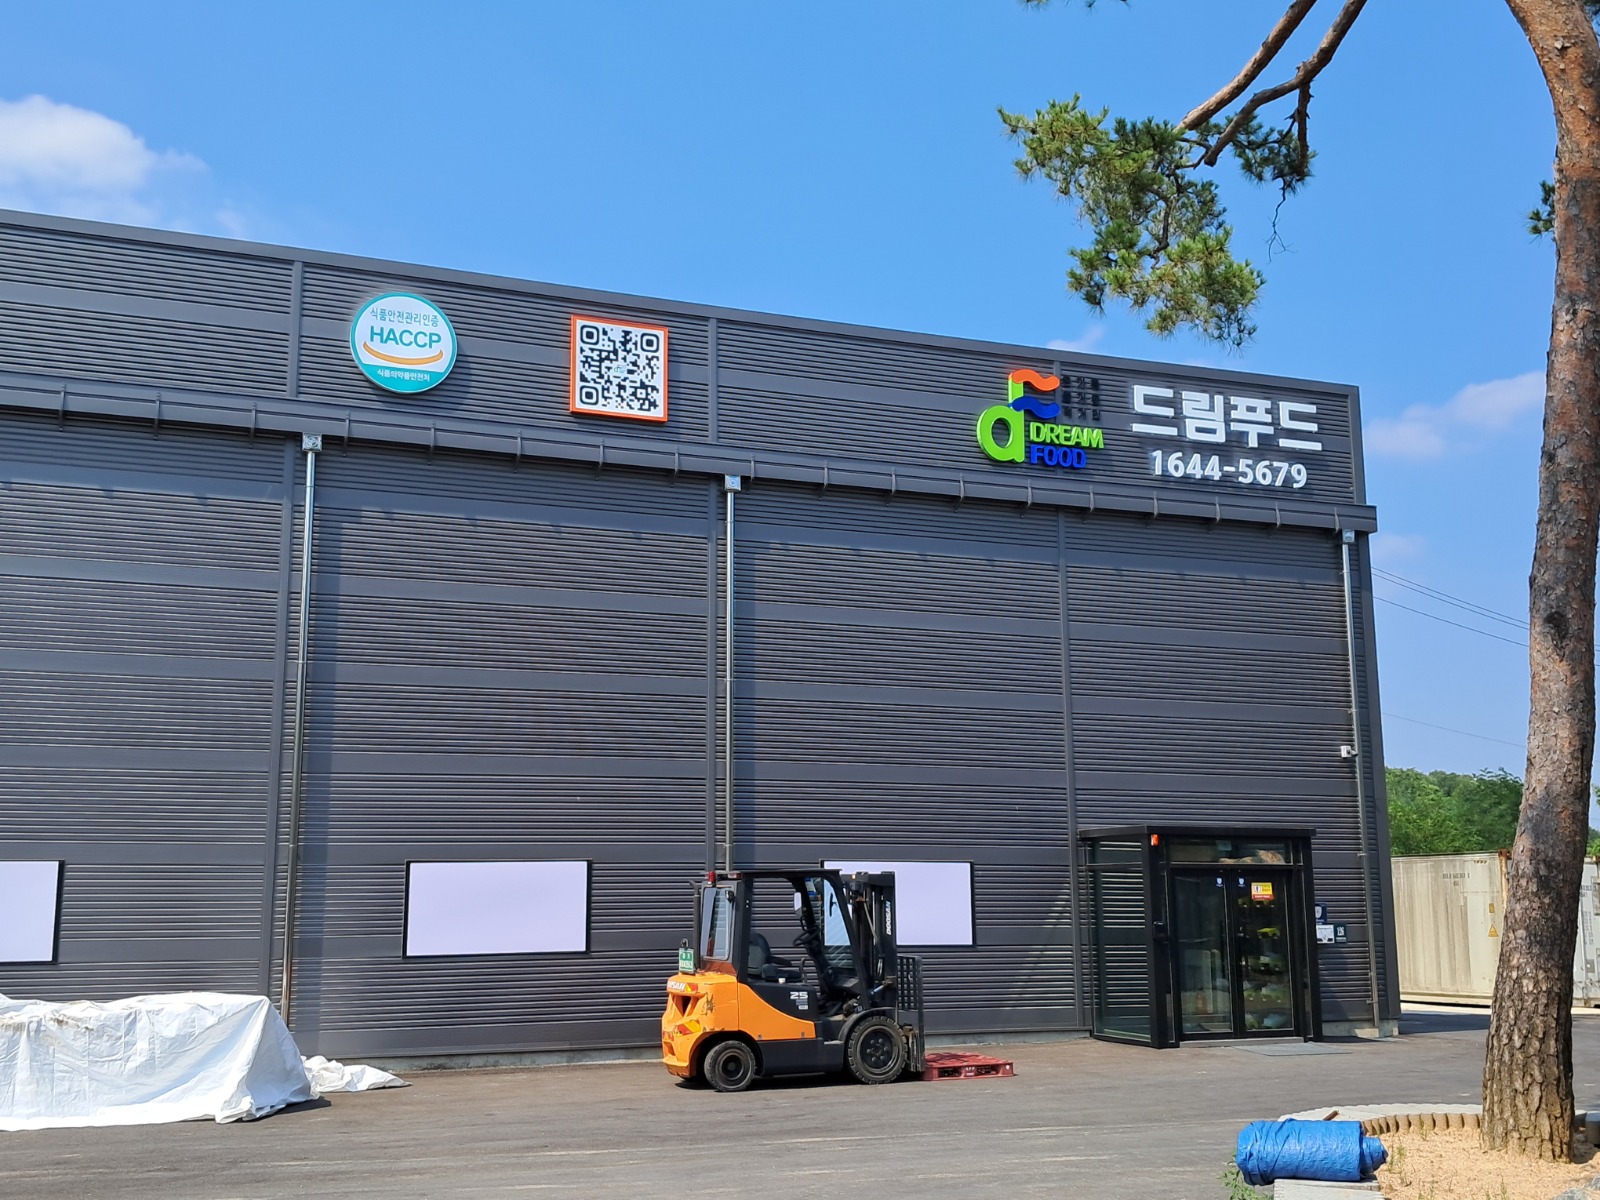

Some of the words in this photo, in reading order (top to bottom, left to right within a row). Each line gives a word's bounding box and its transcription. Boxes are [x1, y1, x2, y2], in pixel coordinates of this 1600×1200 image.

[370, 307, 439, 328] 식품안전관리인증
[369, 325, 442, 349] HACCP
[1131, 384, 1323, 451] 드림푸드
[1029, 421, 1105, 449] DREAM
[1029, 443, 1088, 469] FOOD
[1150, 449, 1308, 489] 1644-5679
[789, 991, 809, 1000] 25
